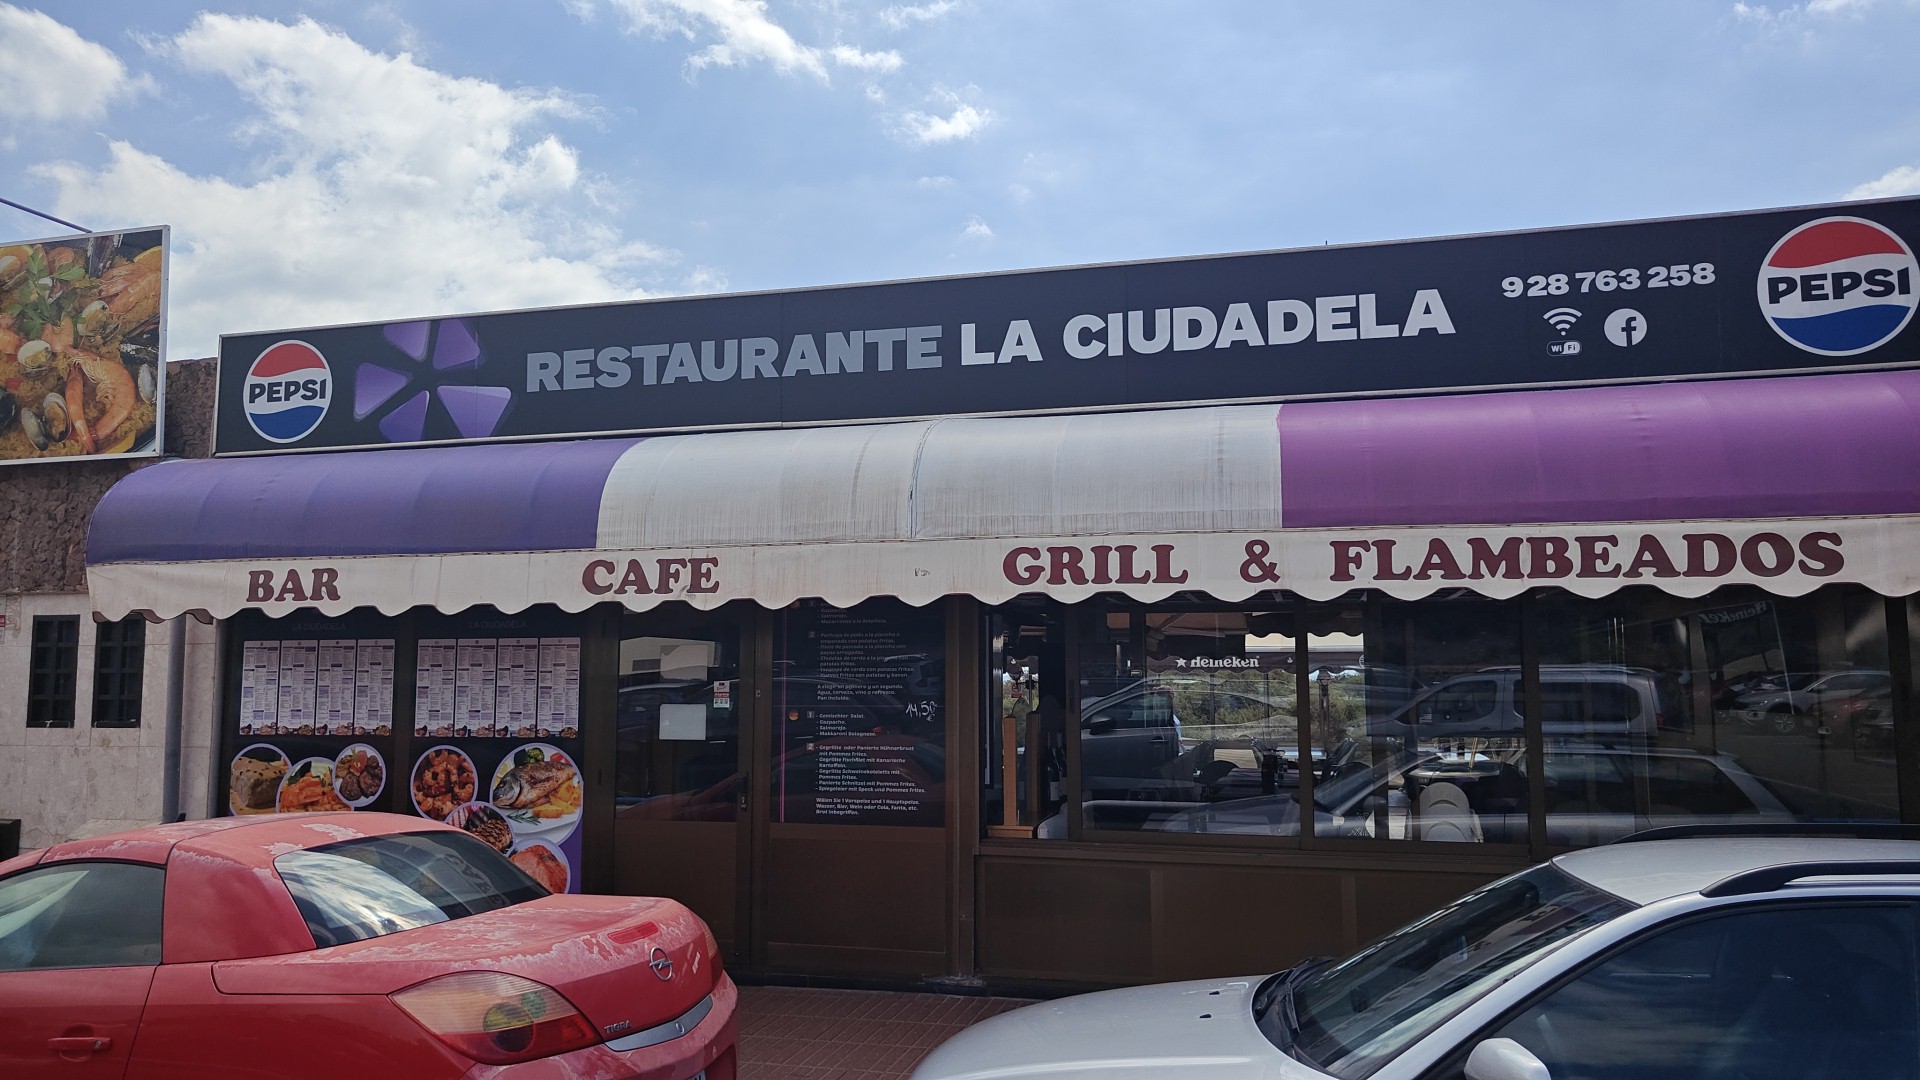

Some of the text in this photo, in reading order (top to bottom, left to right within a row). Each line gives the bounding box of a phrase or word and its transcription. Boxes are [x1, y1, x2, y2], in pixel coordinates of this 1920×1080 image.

[1501, 262, 1716, 298] 928 763 258
[1767, 267, 1911, 304] PEPSI
[526, 288, 1456, 393] RESTAURANTE LA CIUDADELA
[249, 378, 327, 404] PEPSI
[581, 557, 720, 596] CAFE
[1002, 532, 1845, 586] GRILL & FLAMBEADOS
[246, 567, 341, 602] BAR
[604, 1020, 633, 1033] TIGRA
